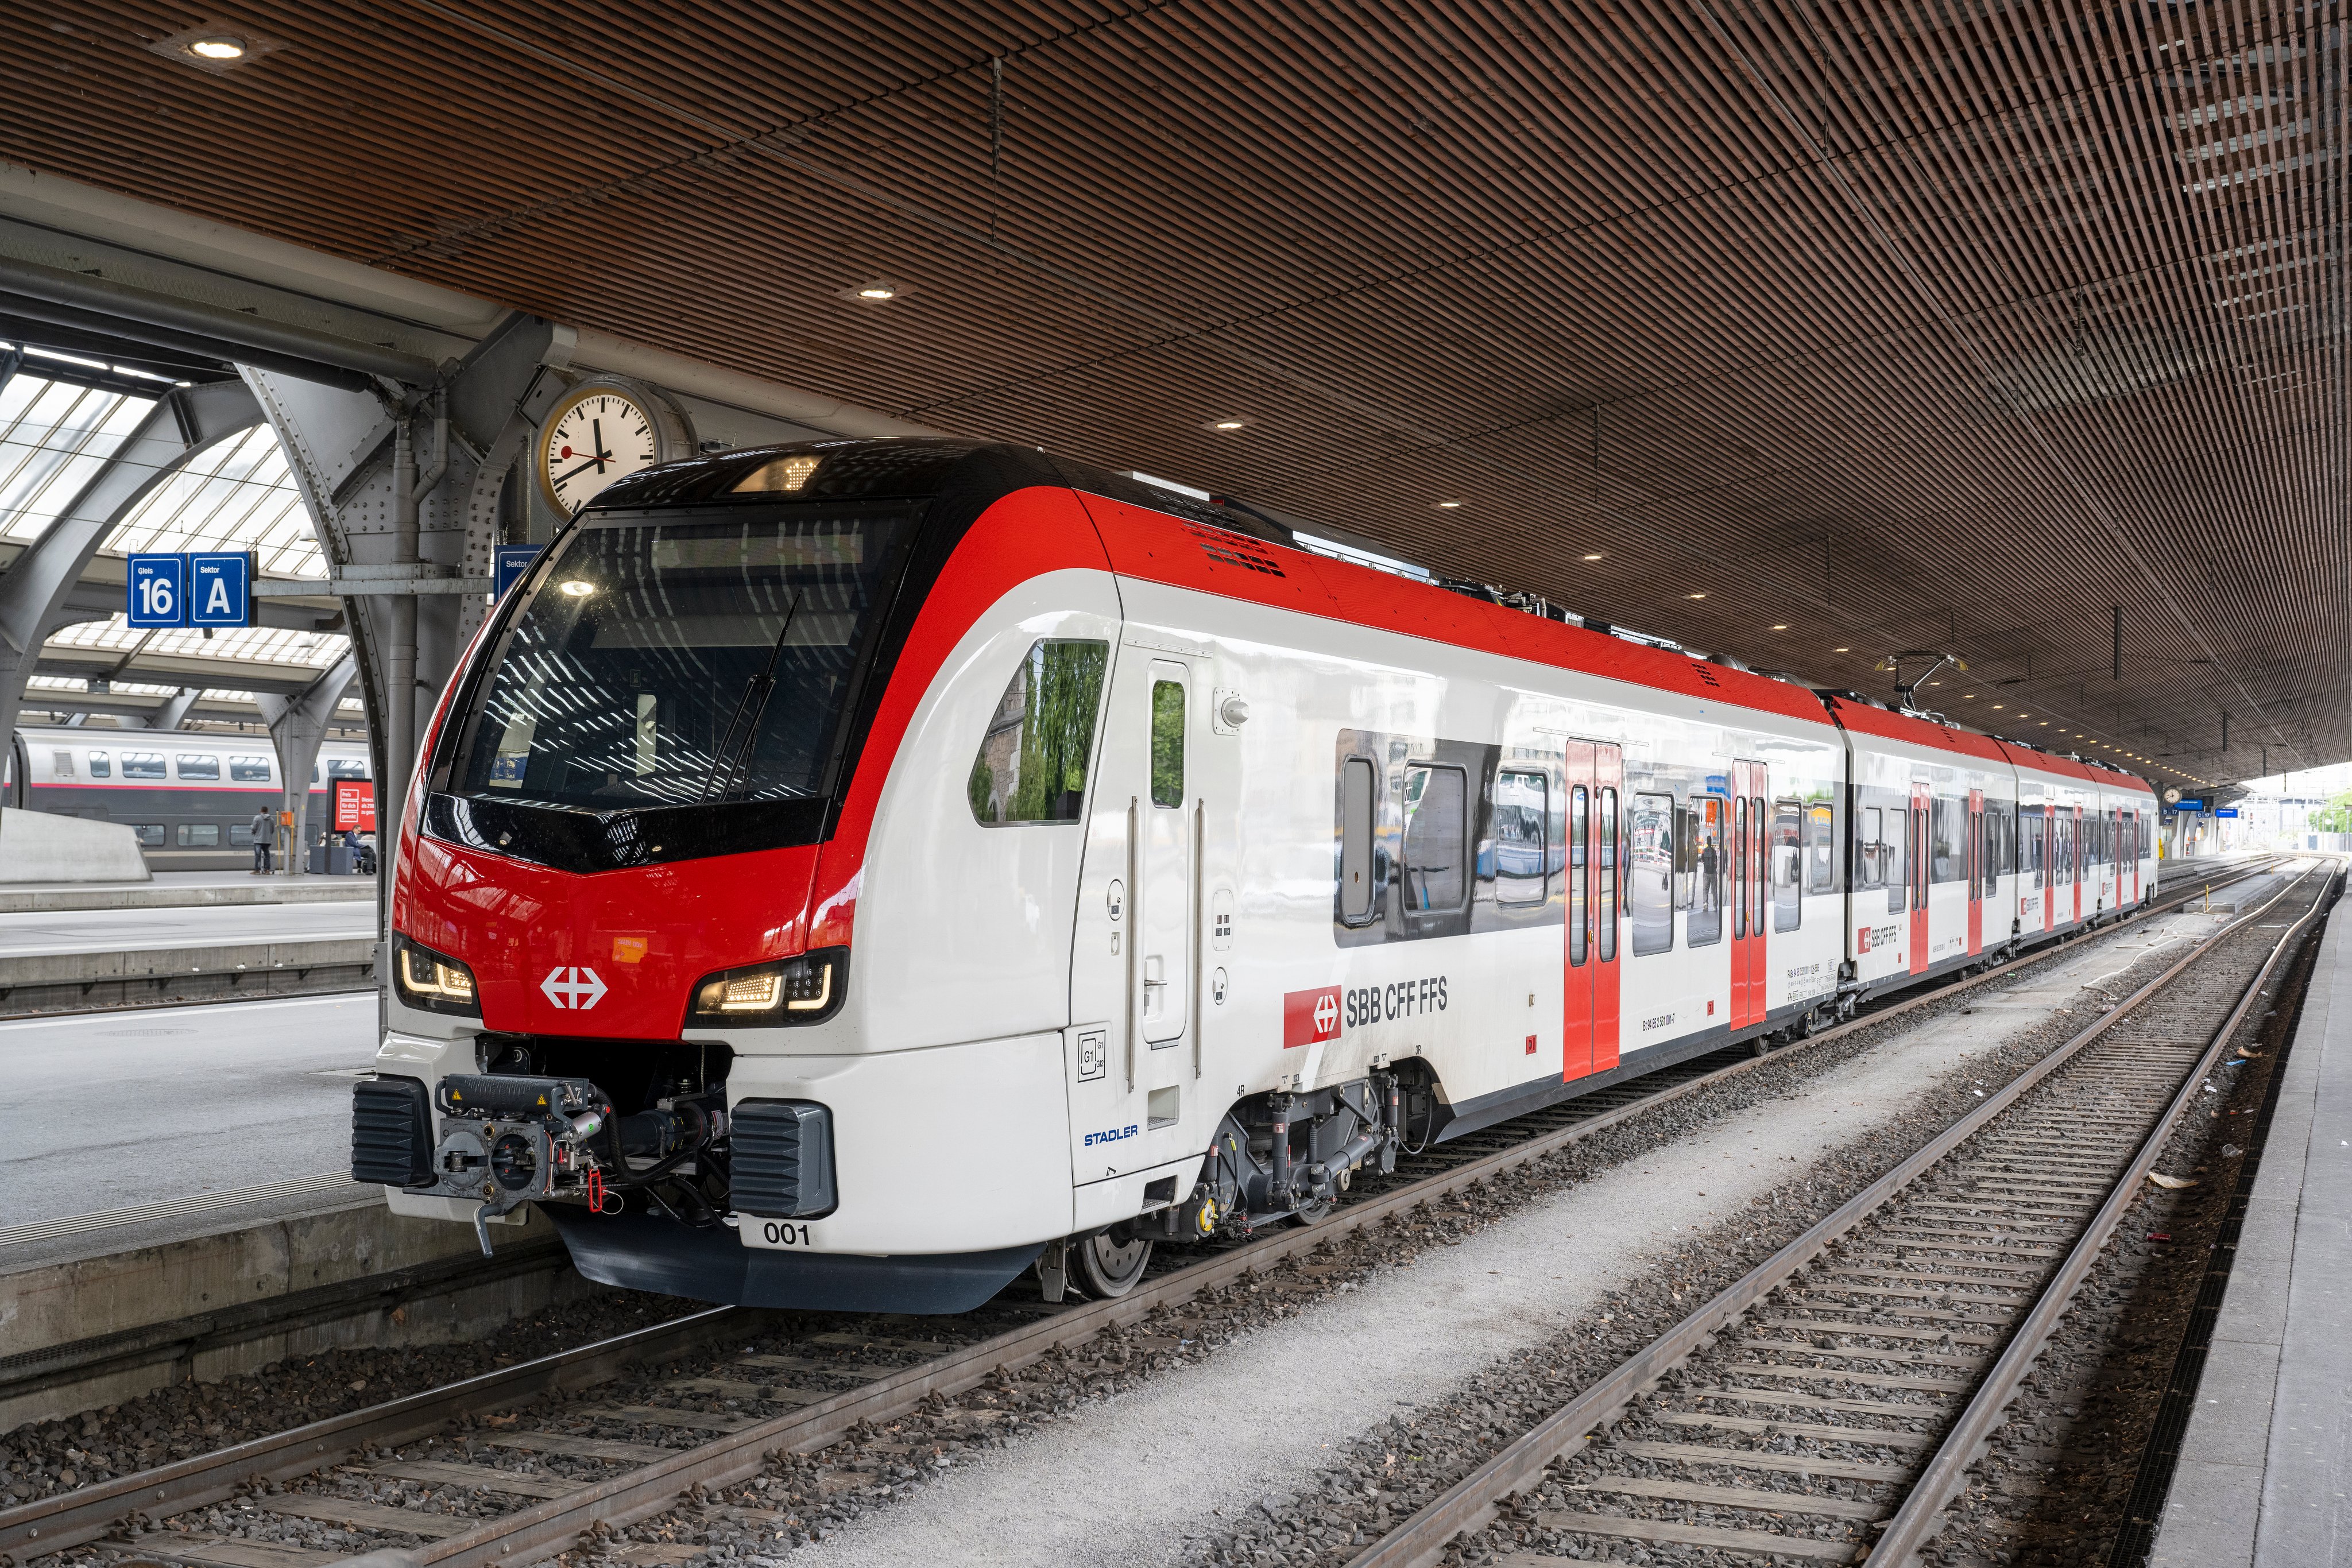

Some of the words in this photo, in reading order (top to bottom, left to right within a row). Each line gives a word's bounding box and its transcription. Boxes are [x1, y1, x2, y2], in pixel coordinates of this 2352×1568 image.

[139, 578, 173, 614] 16
[206, 578, 231, 613] A
[1871, 929, 1880, 948] SBB
[1889, 924, 1897, 944] FFS
[1347, 986, 1381, 1028] SBB
[1385, 981, 1416, 1021] CFF
[1420, 975, 1447, 1014] FFS
[1643, 1020, 1647, 1031] Bt
[1647, 1019, 1651, 1030] 94
[1652, 1018, 1657, 1029] 85
[1657, 1017, 1659, 1028] 2
[1666, 1013, 1675, 1025] 001-7
[1084, 1050, 1093, 1063] G1
[1415, 1044, 1421, 1055] 3R
[1237, 1085, 1245, 1097] 4R
[1085, 1125, 1138, 1147] STADLER
[764, 1222, 810, 1246] 001
